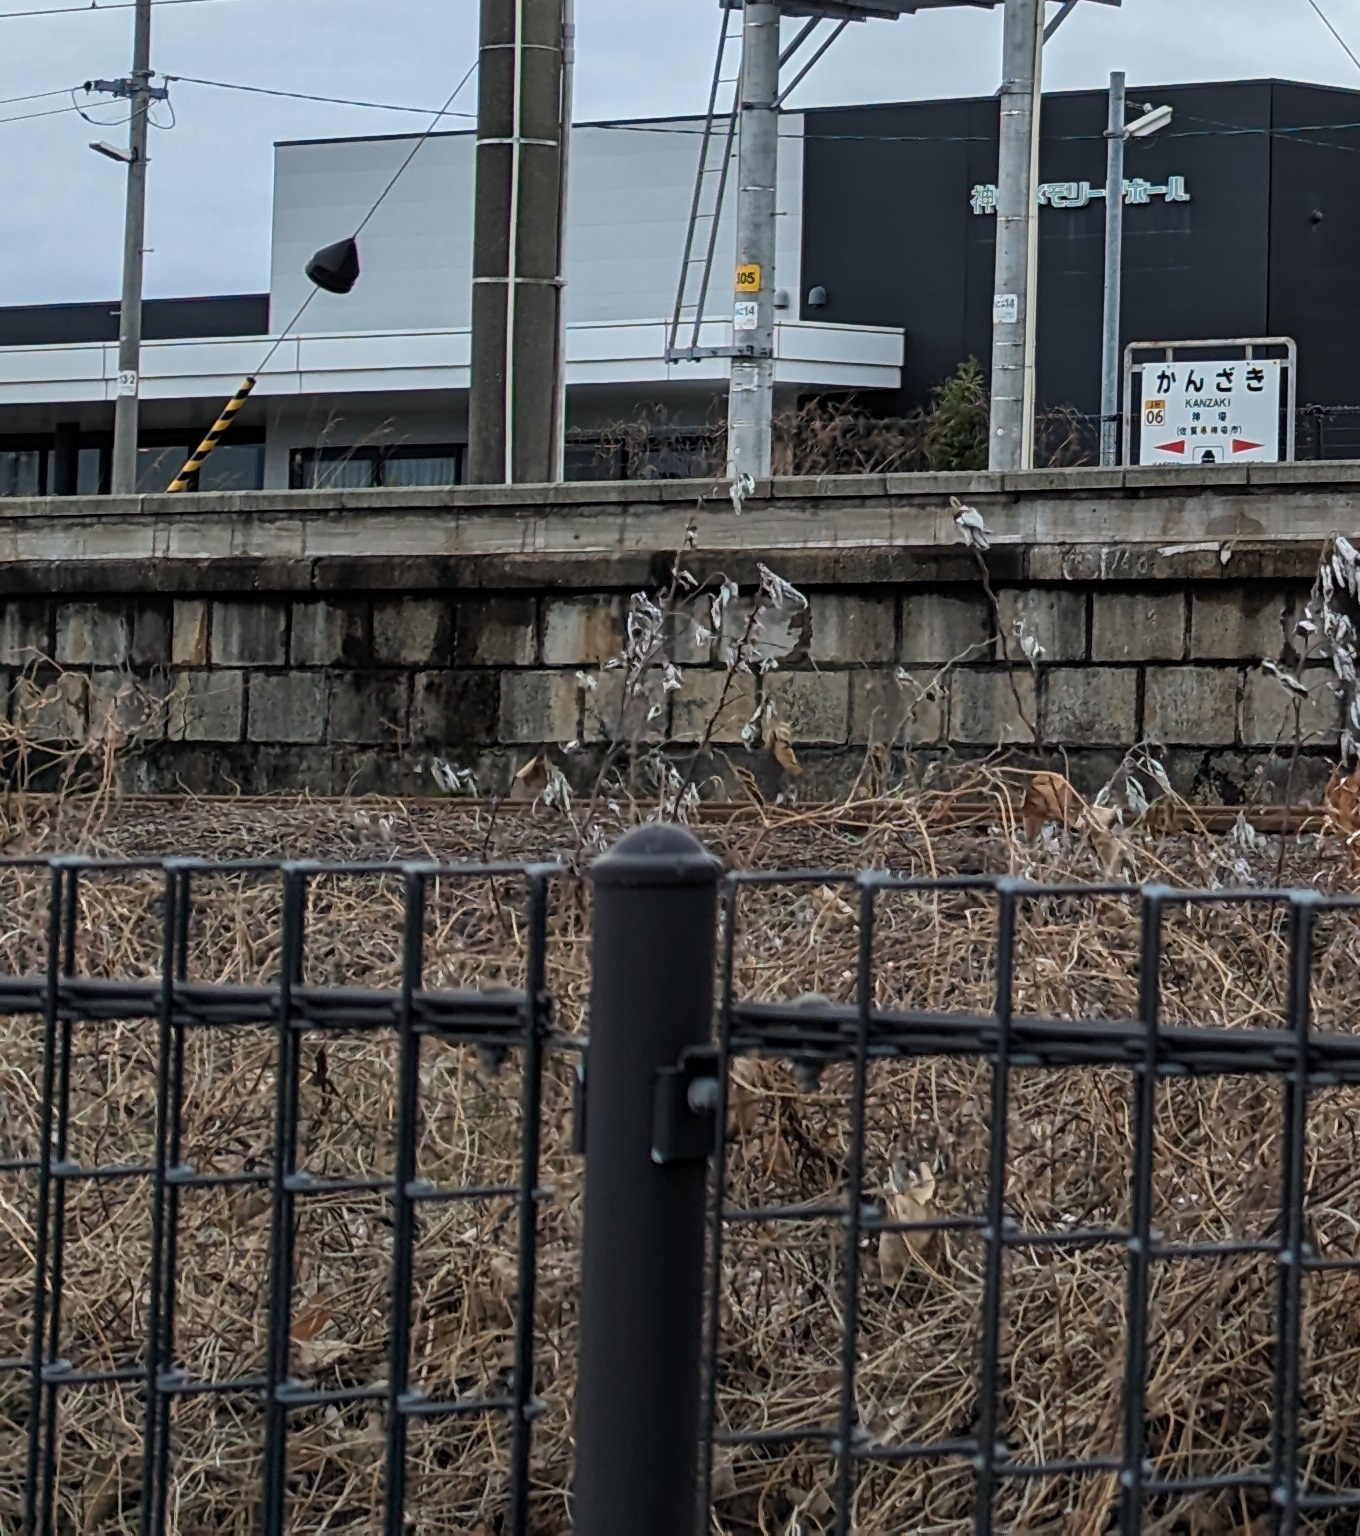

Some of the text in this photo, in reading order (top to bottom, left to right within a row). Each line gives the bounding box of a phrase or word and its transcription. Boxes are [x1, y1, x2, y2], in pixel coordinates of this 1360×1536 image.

[1156, 367, 1265, 394] かんざき
[1185, 398, 1231, 408] KANZAKI
[1147, 410, 1163, 424] 06
